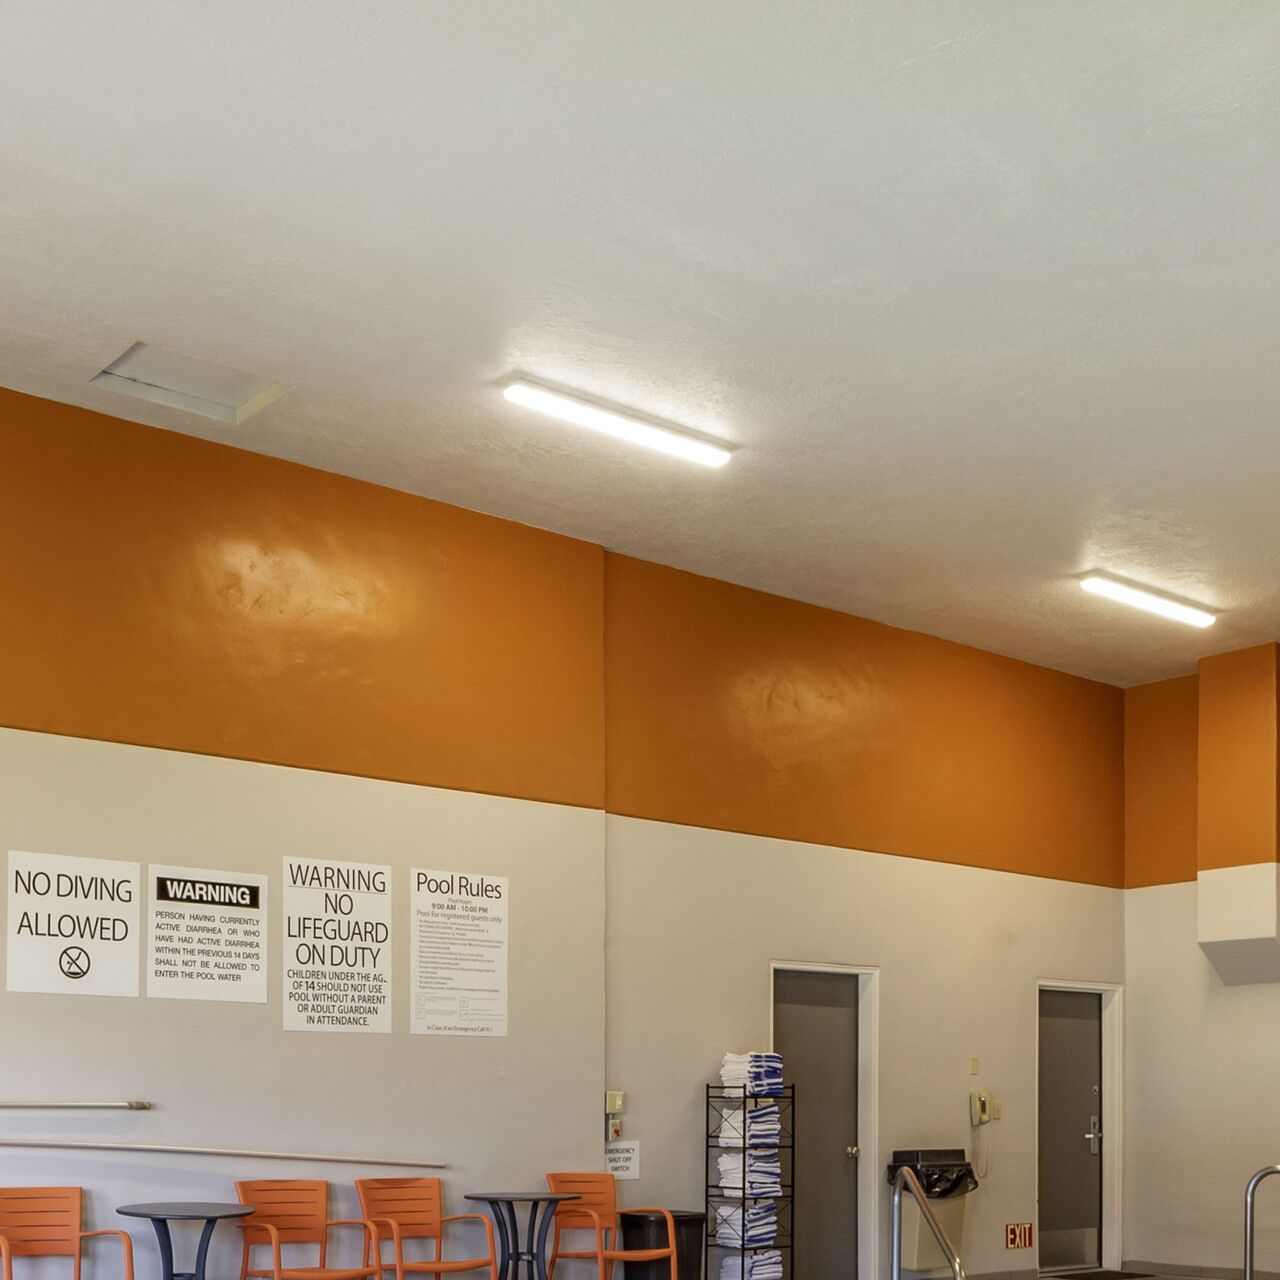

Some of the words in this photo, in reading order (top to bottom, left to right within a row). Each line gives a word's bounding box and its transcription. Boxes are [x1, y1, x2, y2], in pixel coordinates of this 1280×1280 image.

[289, 863, 386, 893] WARNING
[417, 872, 454, 895] Pool
[459, 876, 502, 899] Rules
[15, 869, 51, 896] NO
[56, 874, 132, 903] DIVING
[166, 880, 251, 905] WARNING
[325, 892, 353, 915] NO
[155, 910, 186, 920] PERSON
[189, 914, 216, 923] HAVING
[219, 916, 260, 926] CURRENTLY
[441, 912, 469, 921] registered
[17, 911, 129, 942] ALLOWED
[155, 923, 181, 932] ACTIVE
[186, 925, 222, 934] DIARRHEA
[227, 928, 238, 936] OR
[243, 929, 260, 937] WHO
[288, 916, 388, 944] LIFEGUARD
[155, 934, 175, 943] HAVE
[178, 936, 194, 944] HAD
[197, 937, 221, 946] ACTIVE
[225, 939, 260, 949] DIARRHEA
[155, 946, 181, 955] WITHIN
[183, 947, 196, 956] THE
[197, 949, 232, 958] PREVIOUS
[242, 952, 260, 960] DAYS
[296, 943, 325, 966] ON
[331, 945, 381, 968] DUTY
[154, 958, 178, 966] SHALL
[182, 959, 196, 968] NOT
[200, 961, 210, 969] BE
[214, 962, 247, 971] ALLOWED
[155, 969, 179, 978] ENTER
[181, 971, 194, 979] THE
[196, 972, 215, 980] POOL
[218, 973, 241, 981] WATER
[287, 969, 327, 980] CHILDREN
[329, 971, 355, 981] UNDER
[357, 973, 370, 982] THE
[373, 973, 388, 983] AG
[292, 980, 303, 990] OF
[305, 981, 315, 991] 14
[317, 982, 349, 992] SHOULD
[351, 984, 366, 993] NOT
[368, 984, 383, 994] USE
[289, 992, 311, 1002] POOL
[312, 992, 348, 1003] WITHOUT
[350, 994, 356, 1003] A
[357, 995, 386, 1005] PARENT
[298, 1004, 309, 1013] OR
[311, 1004, 336, 1014] ADULT
[338, 1005, 378, 1015] GUARDIAN
[307, 1015, 314, 1024] IN
[316, 1016, 370, 1026] ATTENDANCE.
[1007, 1224, 1031, 1248] EXIT
